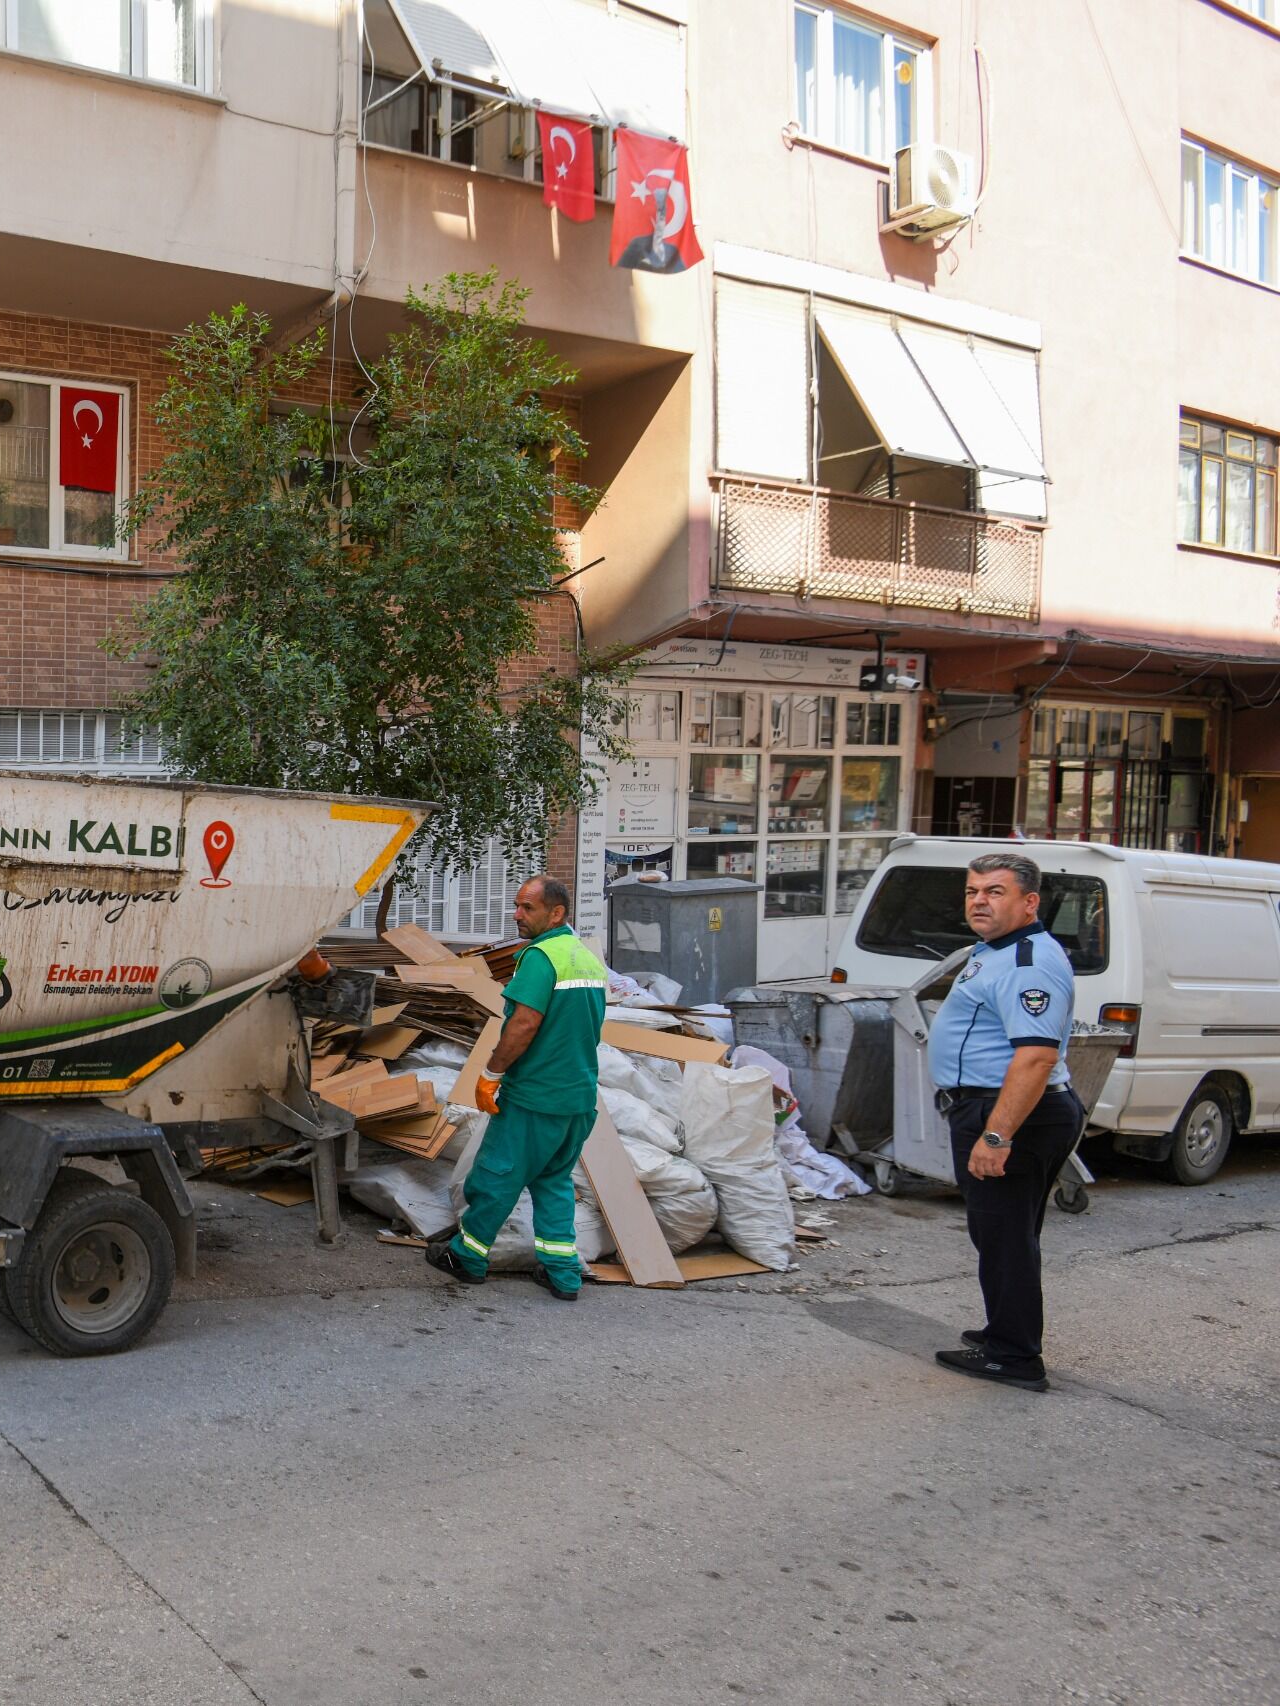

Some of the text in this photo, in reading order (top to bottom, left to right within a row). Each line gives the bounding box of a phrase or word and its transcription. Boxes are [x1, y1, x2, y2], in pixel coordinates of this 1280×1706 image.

[760, 648, 808, 662] ZEG-TECH
[47, 964, 159, 982] Erkan AYDIN
[43, 984, 87, 996] Osmangazi
[88, 985, 121, 996] Belediye
[2, 1066, 23, 1079] 01
